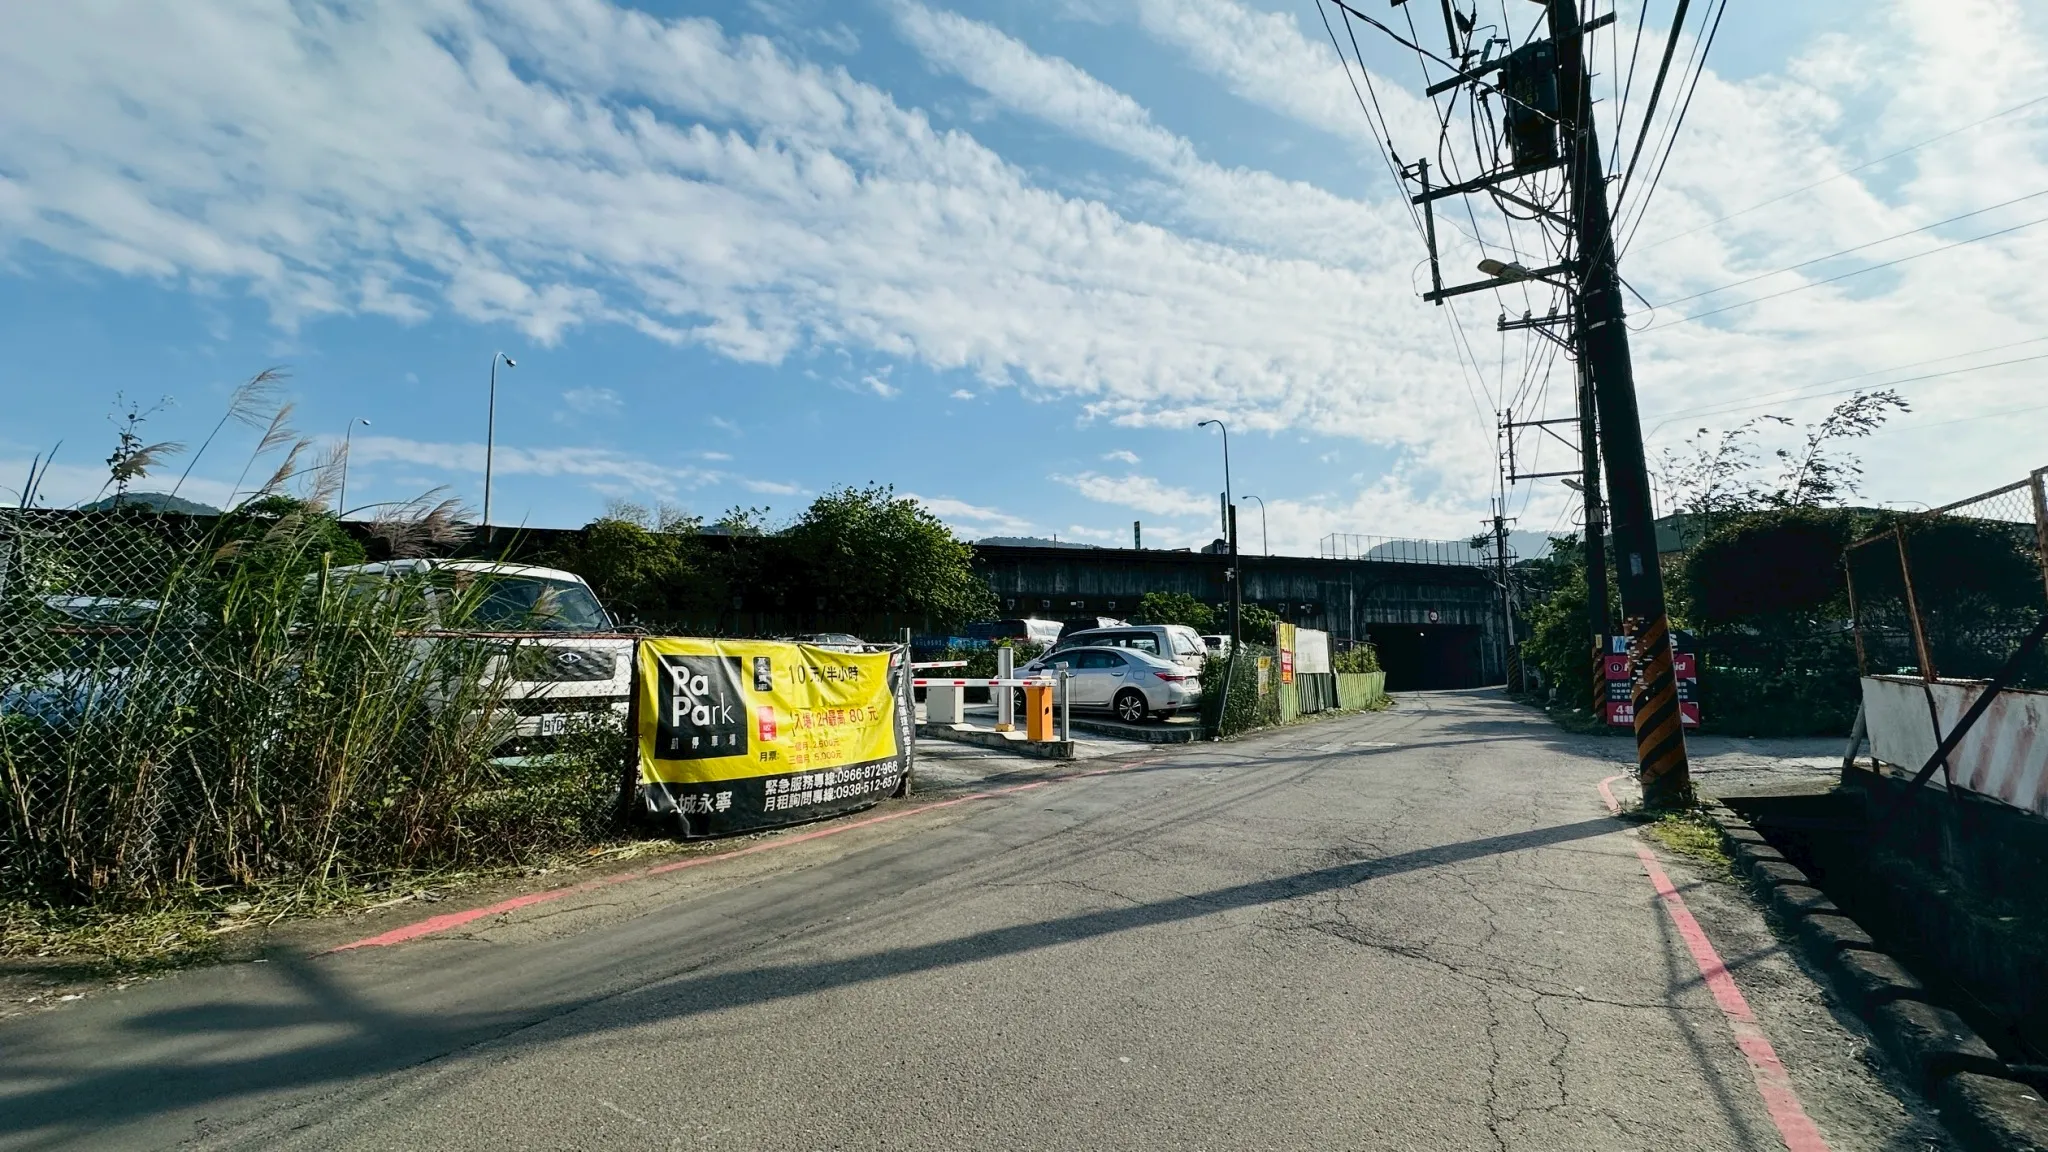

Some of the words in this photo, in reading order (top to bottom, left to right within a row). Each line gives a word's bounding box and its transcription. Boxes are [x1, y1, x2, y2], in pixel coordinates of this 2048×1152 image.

[672, 666, 709, 696] Ra
[789, 665, 806, 684] 10
[673, 692, 735, 727] Park
[849, 708, 863, 723] 80
[867, 706, 878, 721] 元
